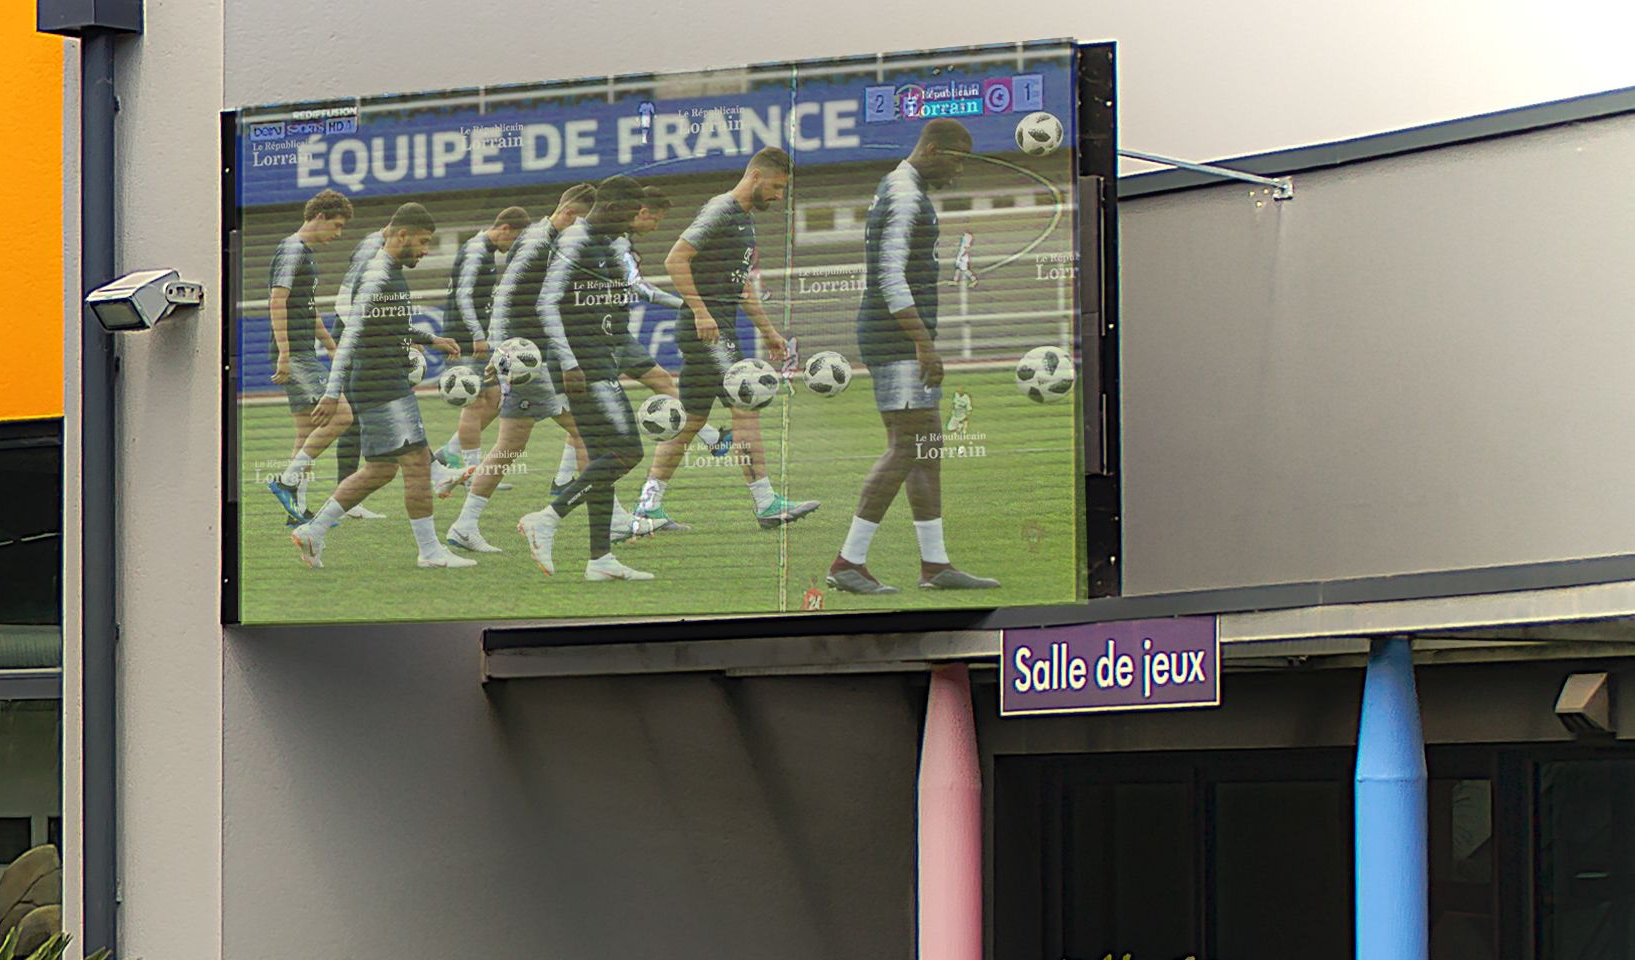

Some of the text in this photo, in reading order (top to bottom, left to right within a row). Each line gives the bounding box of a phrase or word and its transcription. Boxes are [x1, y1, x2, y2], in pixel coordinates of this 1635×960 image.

[875, 83, 1032, 114] 2 1
[907, 99, 980, 118] Lorrain
[679, 115, 745, 135] oain
[252, 138, 310, 153] Le Républic
[296, 99, 861, 193] ÉQUIPE DE FRANCE
[252, 149, 313, 167] Lorran
[798, 274, 868, 295] Lorrain
[574, 288, 640, 307] Lorrain
[361, 300, 423, 319] Lorrain
[916, 430, 986, 443] Le Républicain
[684, 449, 752, 469] Lorrain
[915, 441, 987, 460] Lorrain
[254, 467, 316, 484] Lorain
[463, 458, 528, 477] orrain
[1014, 637, 1207, 699] Salle de jeux
